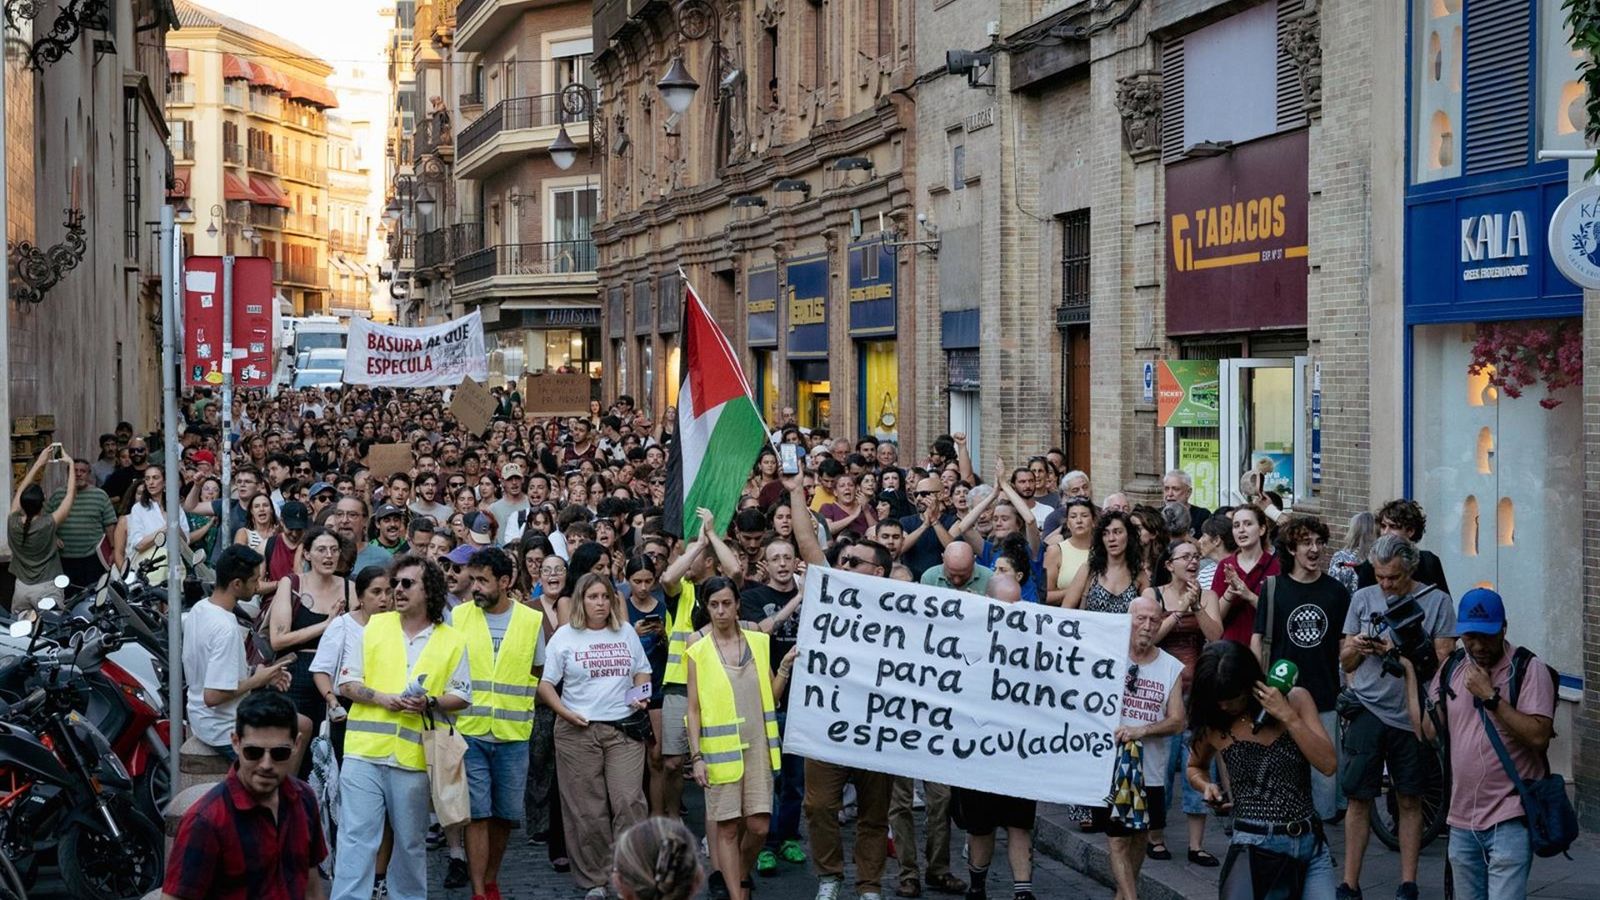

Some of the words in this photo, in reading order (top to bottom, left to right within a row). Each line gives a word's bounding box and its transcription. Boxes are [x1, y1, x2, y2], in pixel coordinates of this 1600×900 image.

[1195, 194, 1286, 249] TABACOS
[1461, 210, 1528, 262] KALA
[367, 332, 423, 353] BASURA
[426, 335, 441, 350] AL
[444, 323, 470, 345] QUE
[367, 355, 433, 375] ESPECULA
[820, 574, 862, 609] La
[879, 591, 964, 620] casa
[987, 603, 1082, 640] para
[589, 642, 628, 650] SINDICATO
[589, 659, 632, 668] INQUILINOS
[813, 612, 906, 649] quien
[924, 623, 963, 660] la
[989, 630, 1116, 680] habita
[601, 669, 630, 677] SEVILLA
[807, 650, 850, 678] no
[876, 658, 962, 694] para
[991, 668, 1118, 716] bancos
[804, 685, 840, 713] ni
[866, 692, 953, 730] para
[827, 720, 1113, 759] especuculadores
